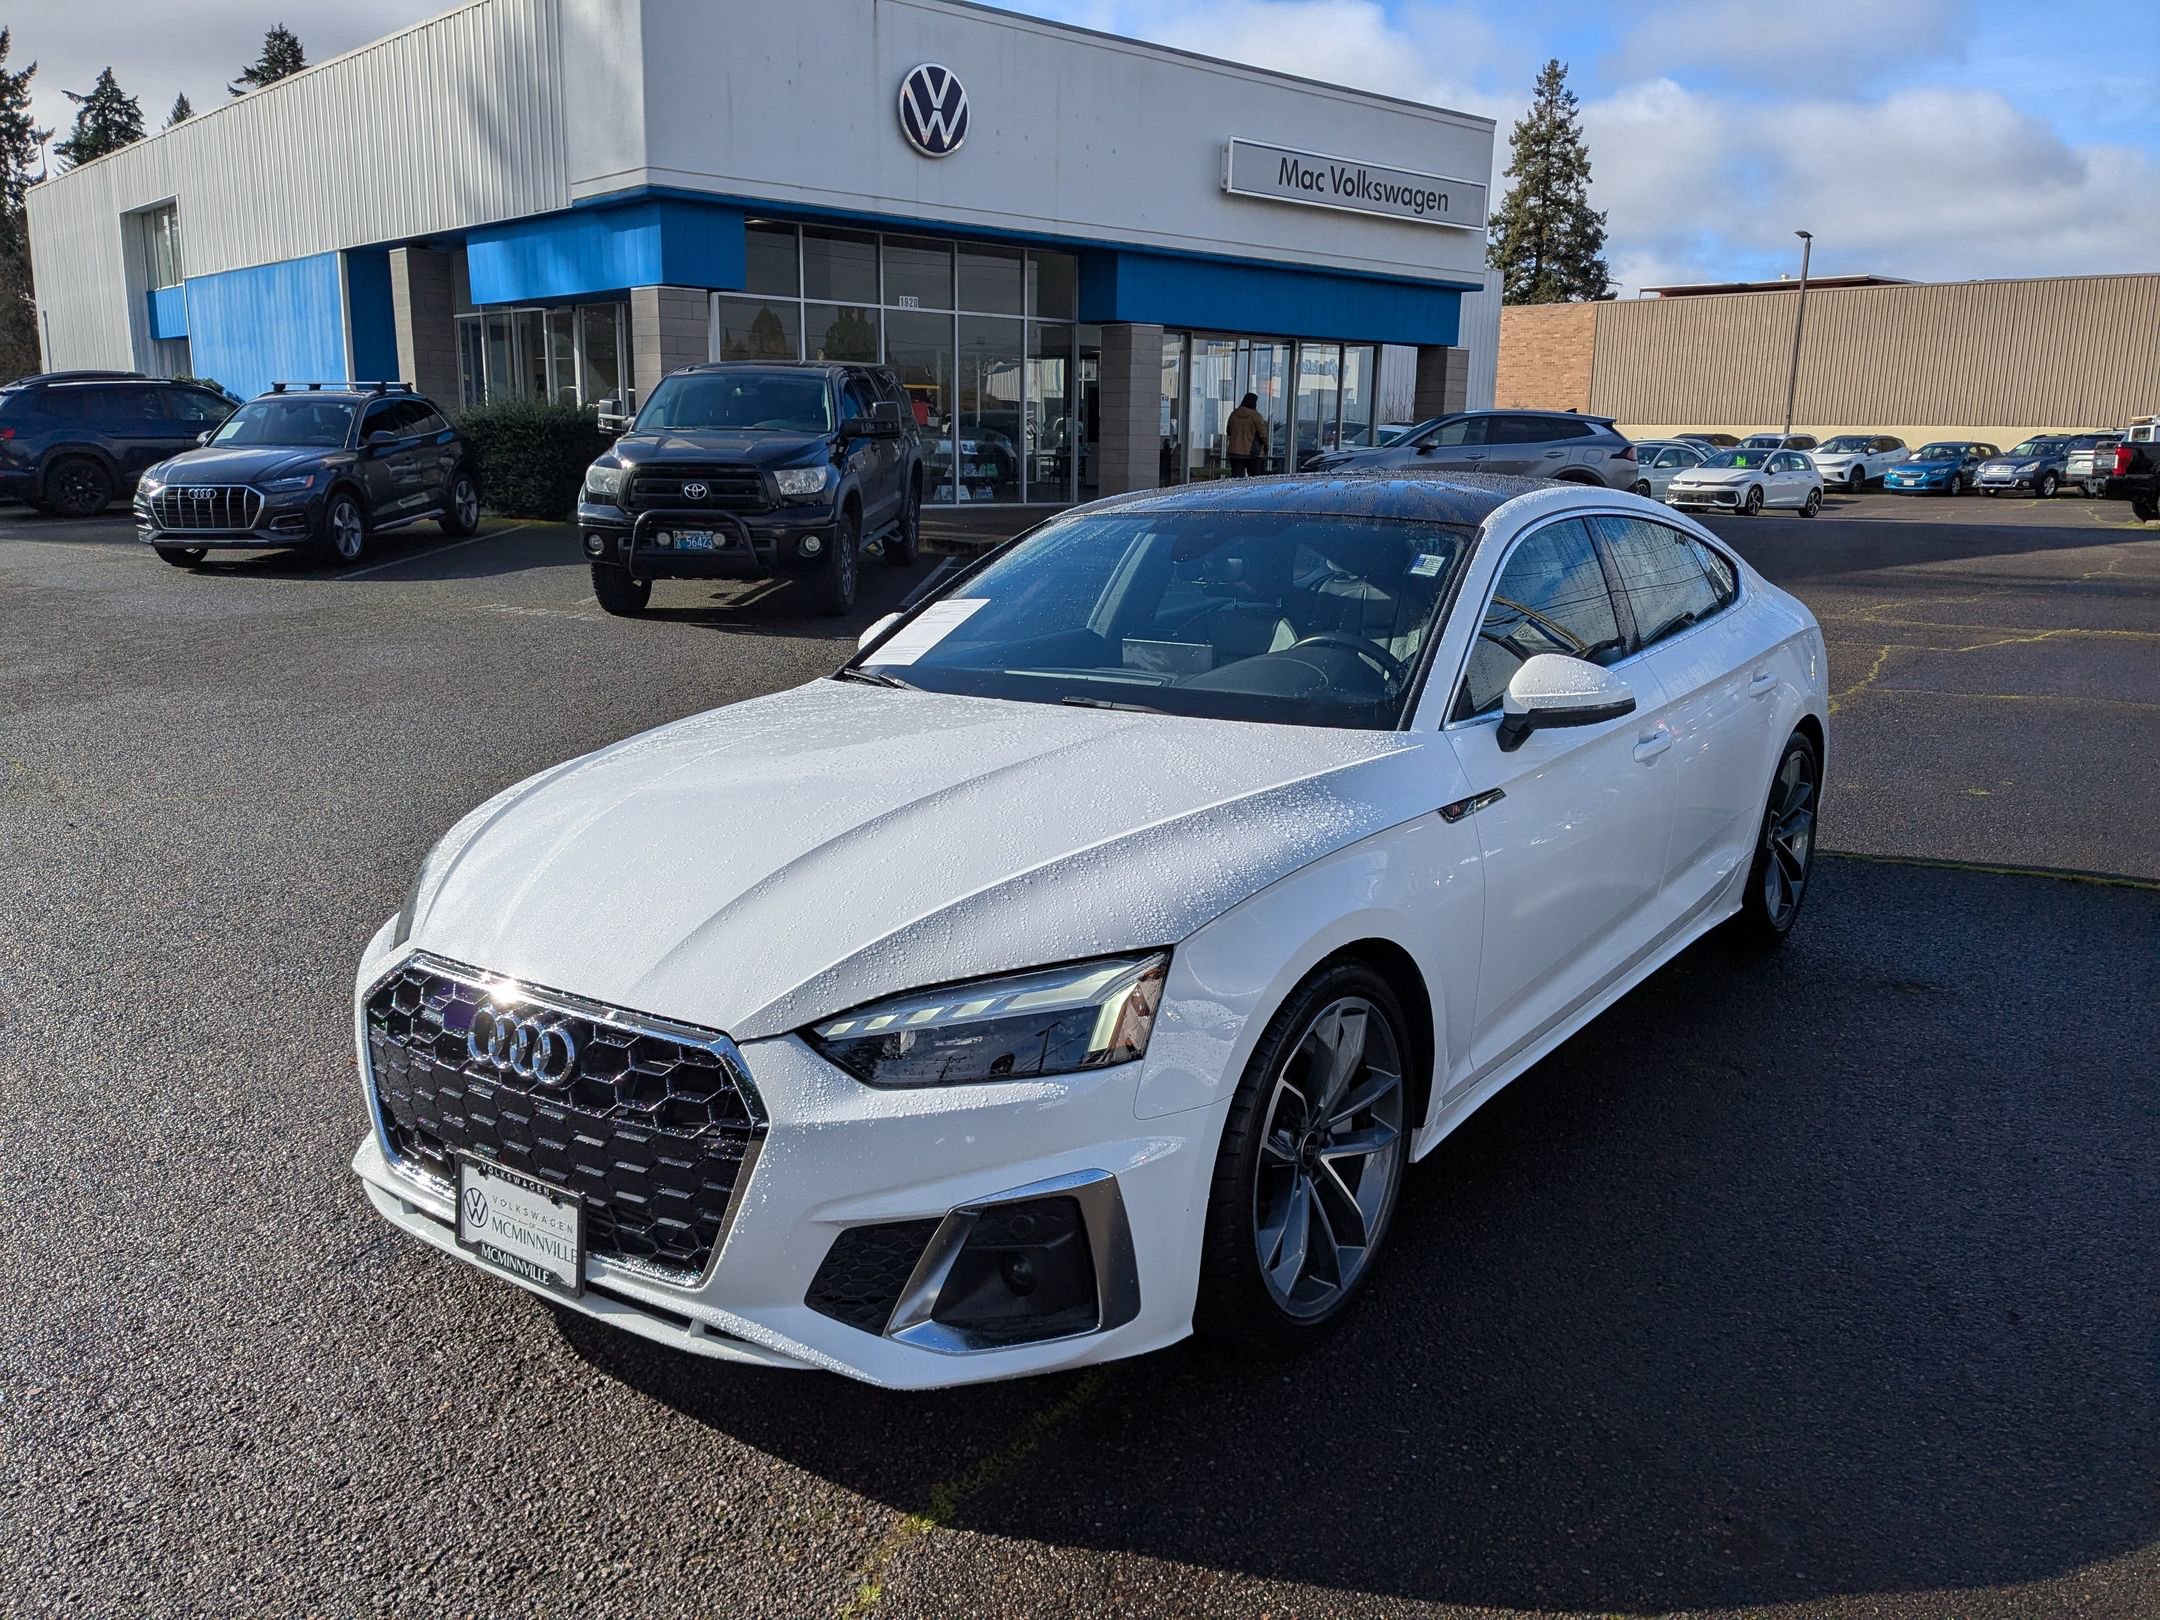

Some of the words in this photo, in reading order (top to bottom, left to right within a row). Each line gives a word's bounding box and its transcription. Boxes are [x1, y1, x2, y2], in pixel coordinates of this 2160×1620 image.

[1278, 156, 1326, 193] Mac
[1330, 165, 1449, 215] Volkswagen
[900, 297, 918, 308] 1920
[481, 1163, 551, 1196] VOLKSWAGEN
[492, 1195, 574, 1234] VOLKSWAGEN
[491, 1216, 578, 1265] MCMINNVILLE
[481, 1243, 550, 1286] MCMINNVILLE
